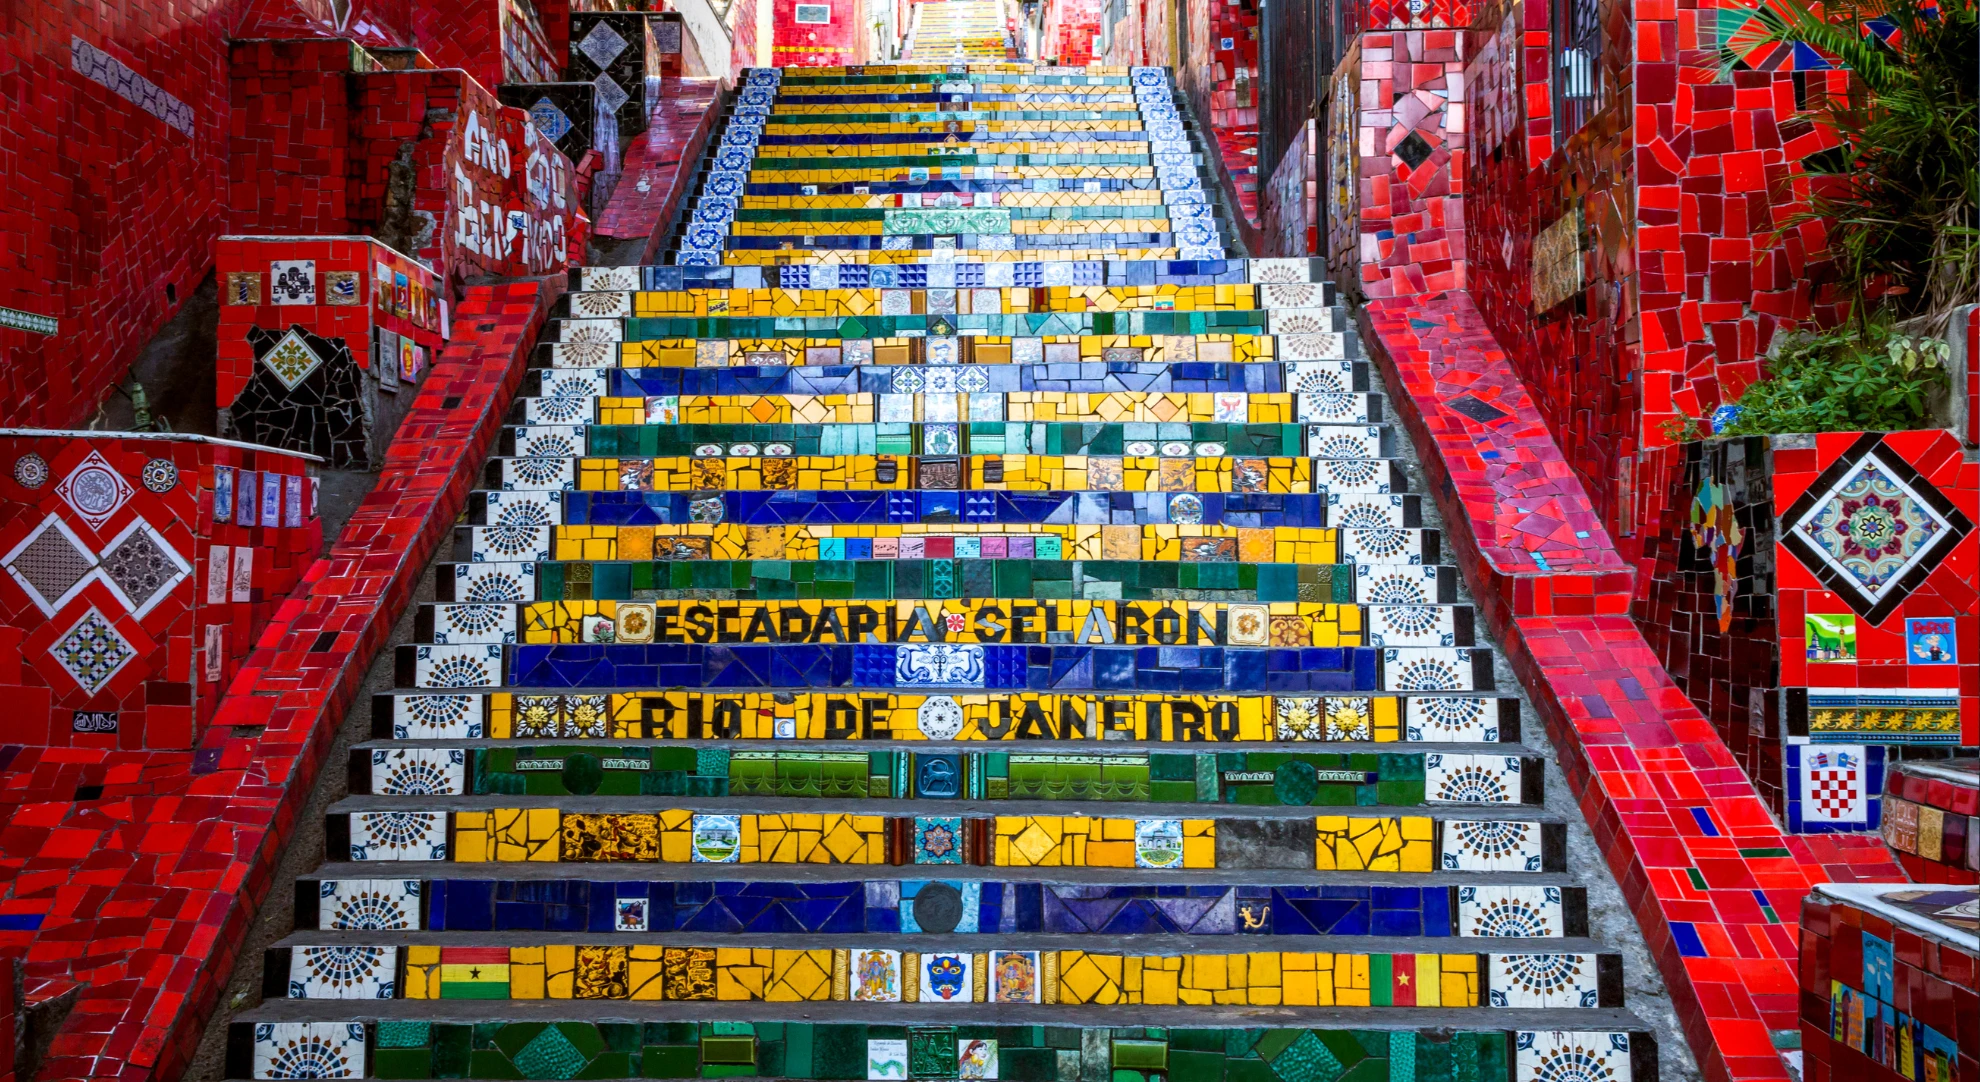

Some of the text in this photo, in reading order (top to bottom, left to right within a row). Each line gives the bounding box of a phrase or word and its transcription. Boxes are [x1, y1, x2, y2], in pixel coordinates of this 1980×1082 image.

[655, 605, 1229, 646] ESCADARIA SELARON
[1912, 621, 1952, 635] POPEYE
[641, 699, 1239, 742] RIO DE JANEIRO
